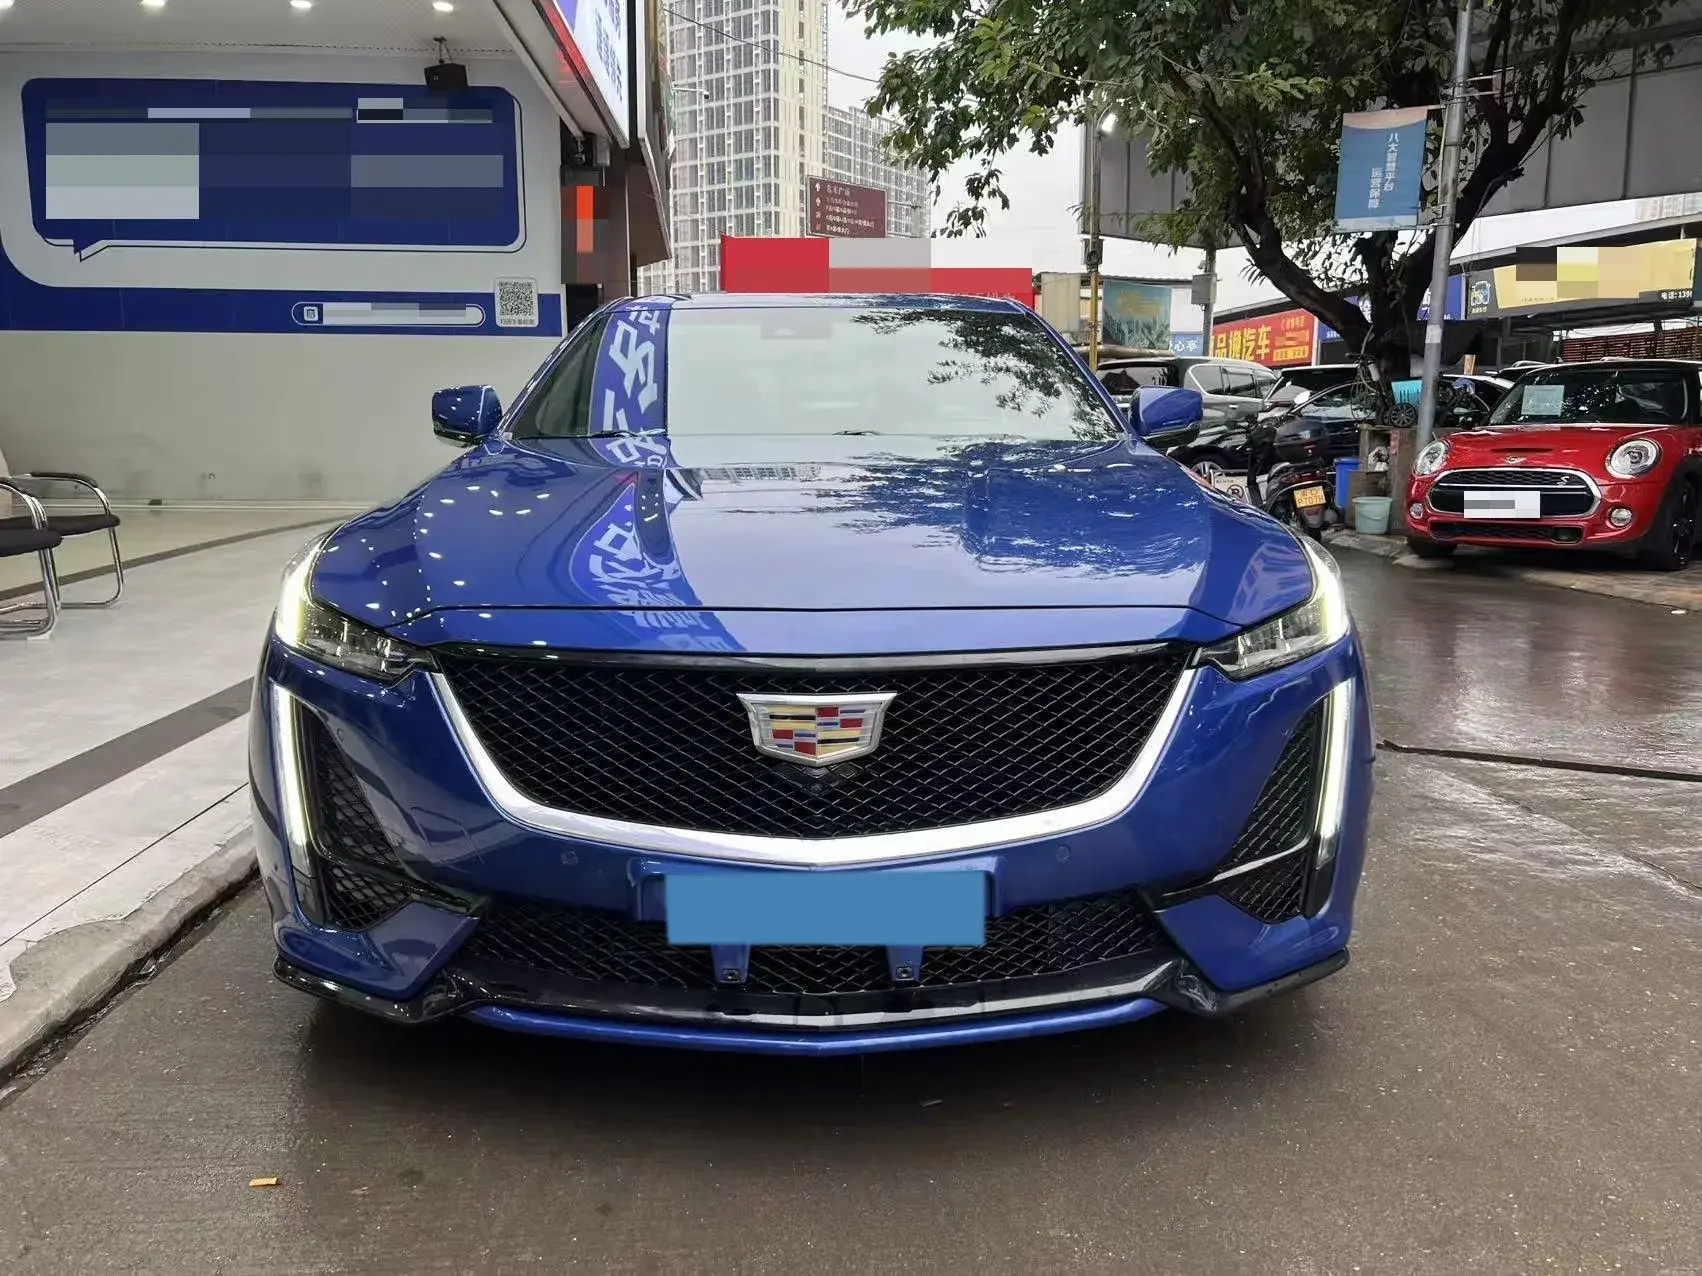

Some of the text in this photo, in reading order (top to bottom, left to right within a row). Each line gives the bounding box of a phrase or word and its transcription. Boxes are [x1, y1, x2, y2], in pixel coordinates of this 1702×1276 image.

[1383, 133, 1399, 191] 八大智慧平台
[1368, 167, 1383, 209] 运营保障
